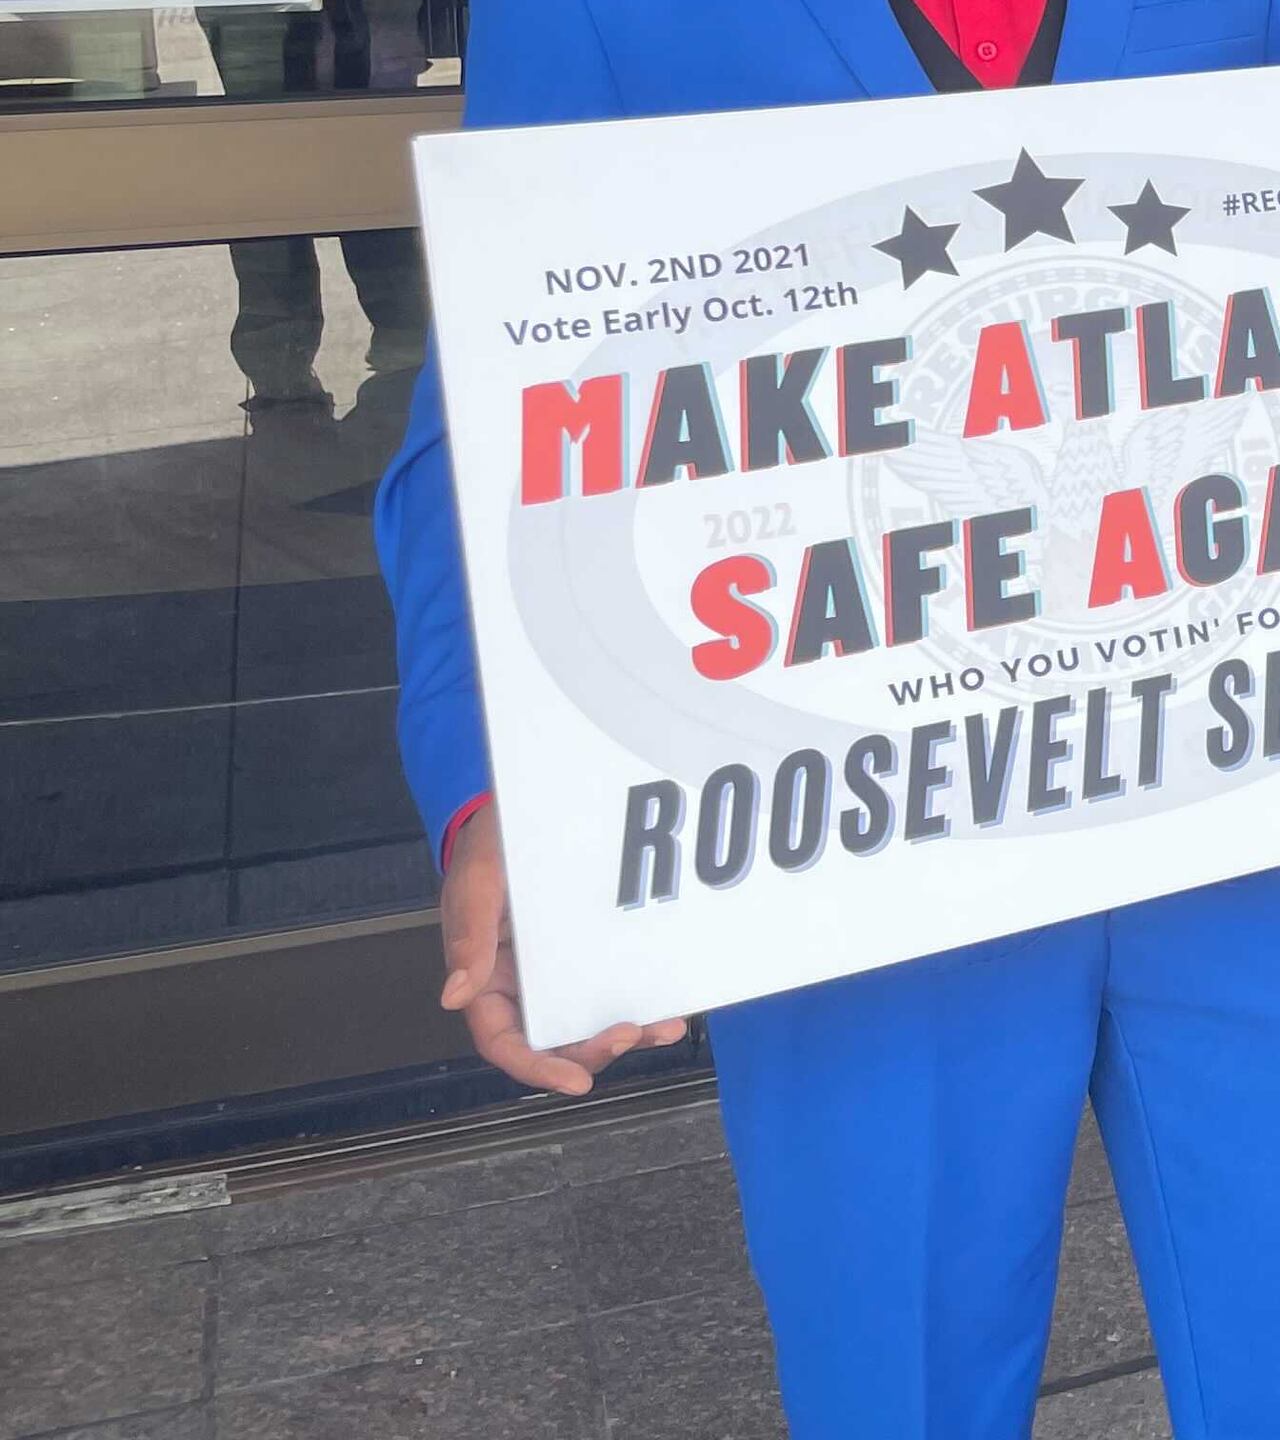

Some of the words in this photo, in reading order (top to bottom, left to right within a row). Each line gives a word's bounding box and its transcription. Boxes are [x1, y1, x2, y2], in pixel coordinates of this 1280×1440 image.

[504, 317, 592, 346] Vote
[603, 302, 691, 335] Early
[703, 293, 773, 323] Oct.
[783, 281, 859, 312] 12th
[545, 262, 638, 296] NOV.
[649, 253, 722, 284] 2ND
[733, 243, 810, 274] 2021
[520, 334, 914, 504] MAKE
[704, 503, 796, 549] 2022
[690, 505, 1042, 681] SAFE
[889, 665, 985, 708] WHO
[1000, 646, 1081, 686] YOU
[1094, 617, 1222, 666] VOTIN'
[616, 672, 1180, 911] ROOSEVELT
